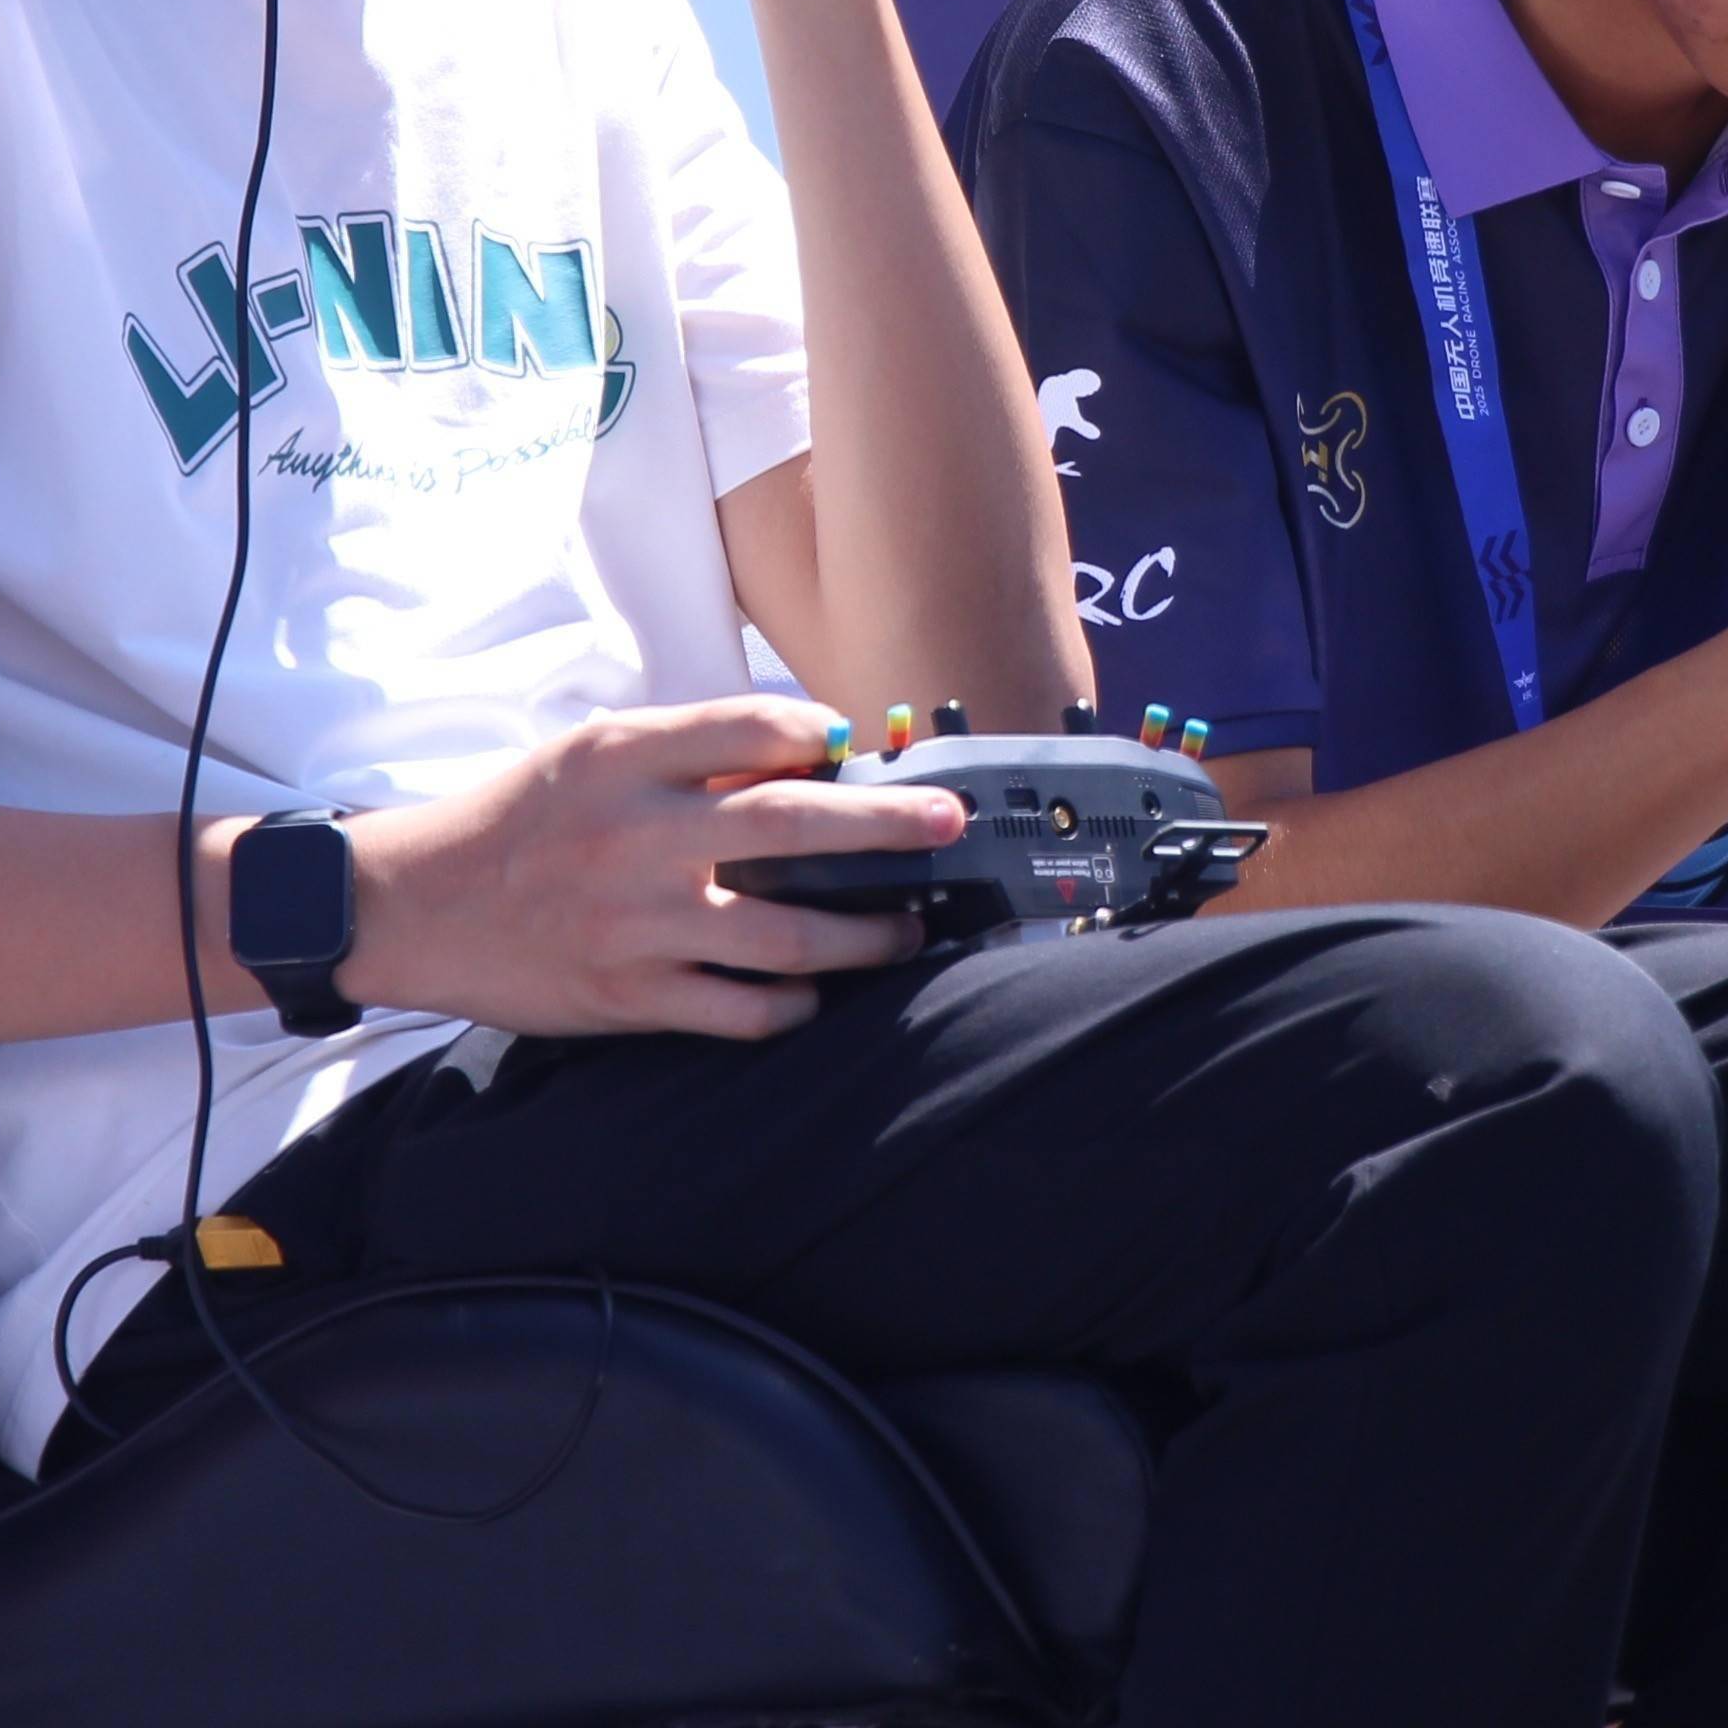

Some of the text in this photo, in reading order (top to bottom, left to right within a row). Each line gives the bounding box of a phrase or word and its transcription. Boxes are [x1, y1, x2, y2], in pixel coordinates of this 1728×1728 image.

[1416, 175, 1475, 421] 中国无人机竞速联赛
[1455, 270, 1473, 322] RACING
[1468, 330, 1483, 379] DRONE
[1473, 385, 1489, 416] 2025
